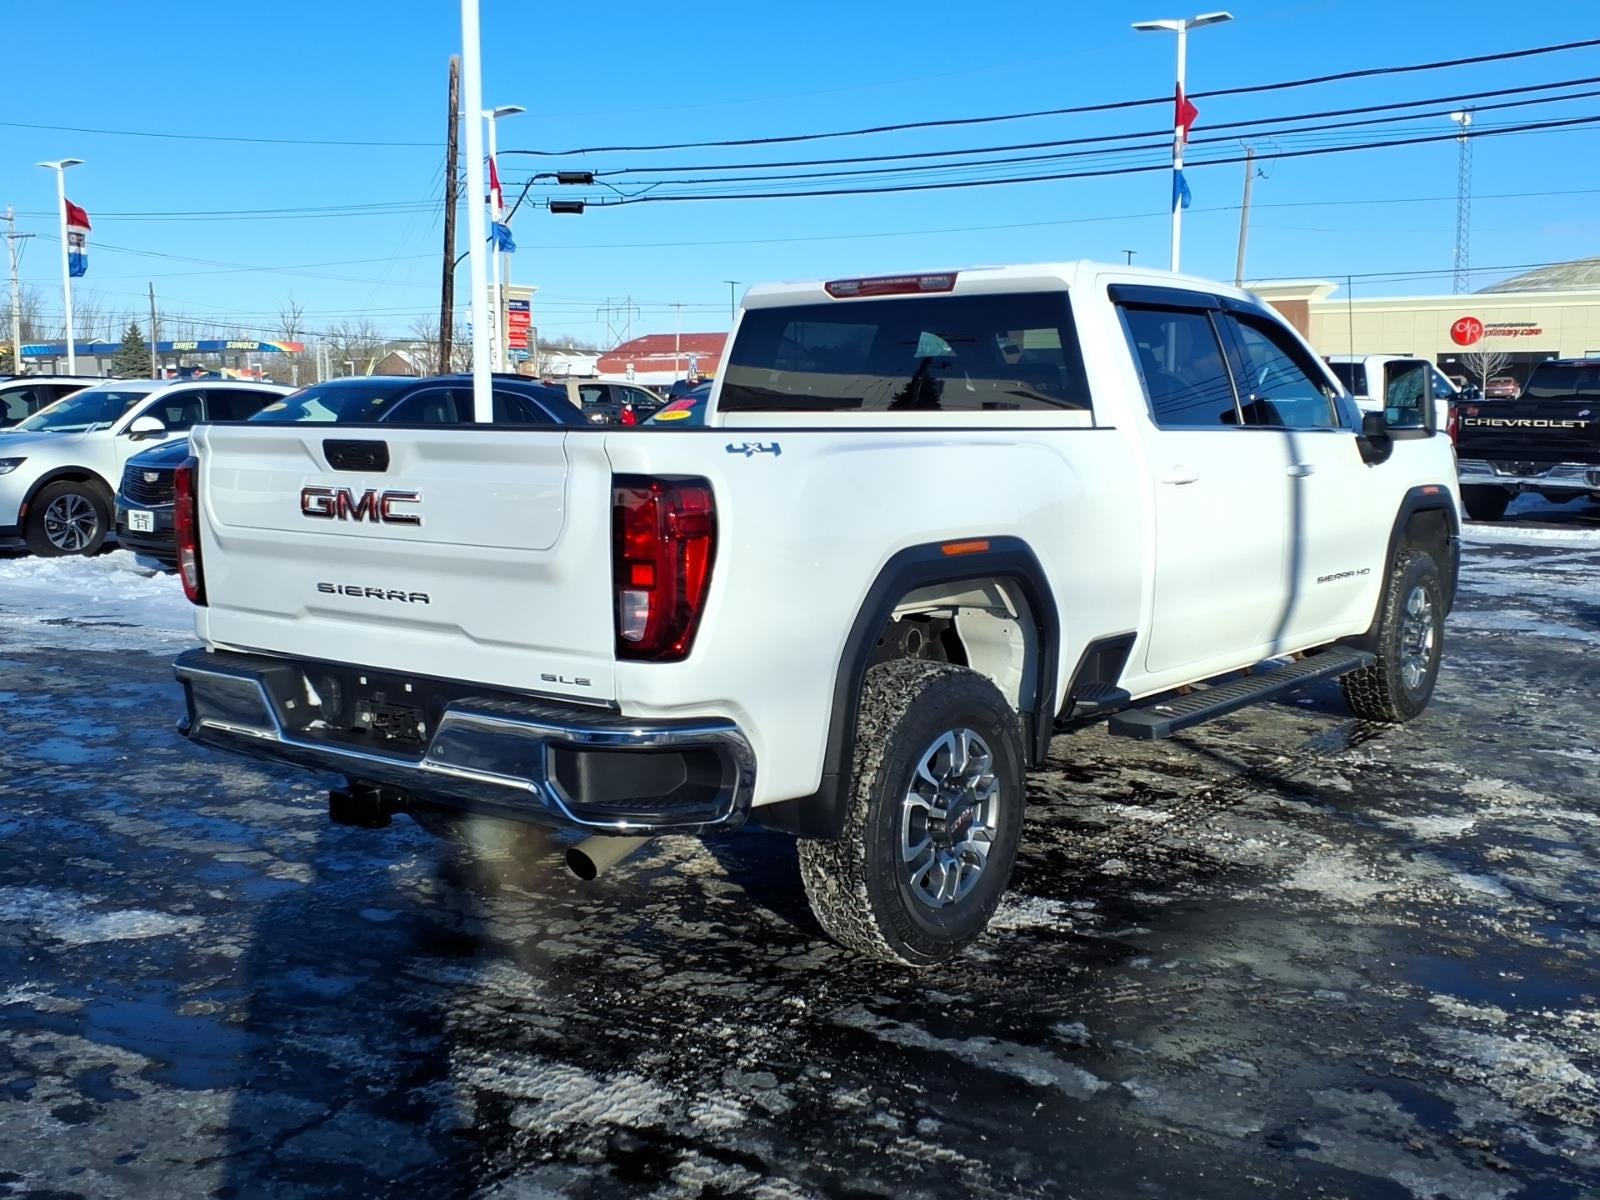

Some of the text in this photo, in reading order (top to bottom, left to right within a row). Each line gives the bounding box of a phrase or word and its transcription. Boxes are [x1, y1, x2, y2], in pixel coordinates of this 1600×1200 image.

[172, 341, 198, 350] SUNOCO
[226, 341, 260, 350] SUNOCO
[1464, 417, 1590, 429] CHEVROLET
[300, 485, 422, 527] GMC
[1316, 568, 1371, 584] SIERRA HD
[317, 582, 430, 605] SIERRA
[541, 673, 592, 687] SLE
